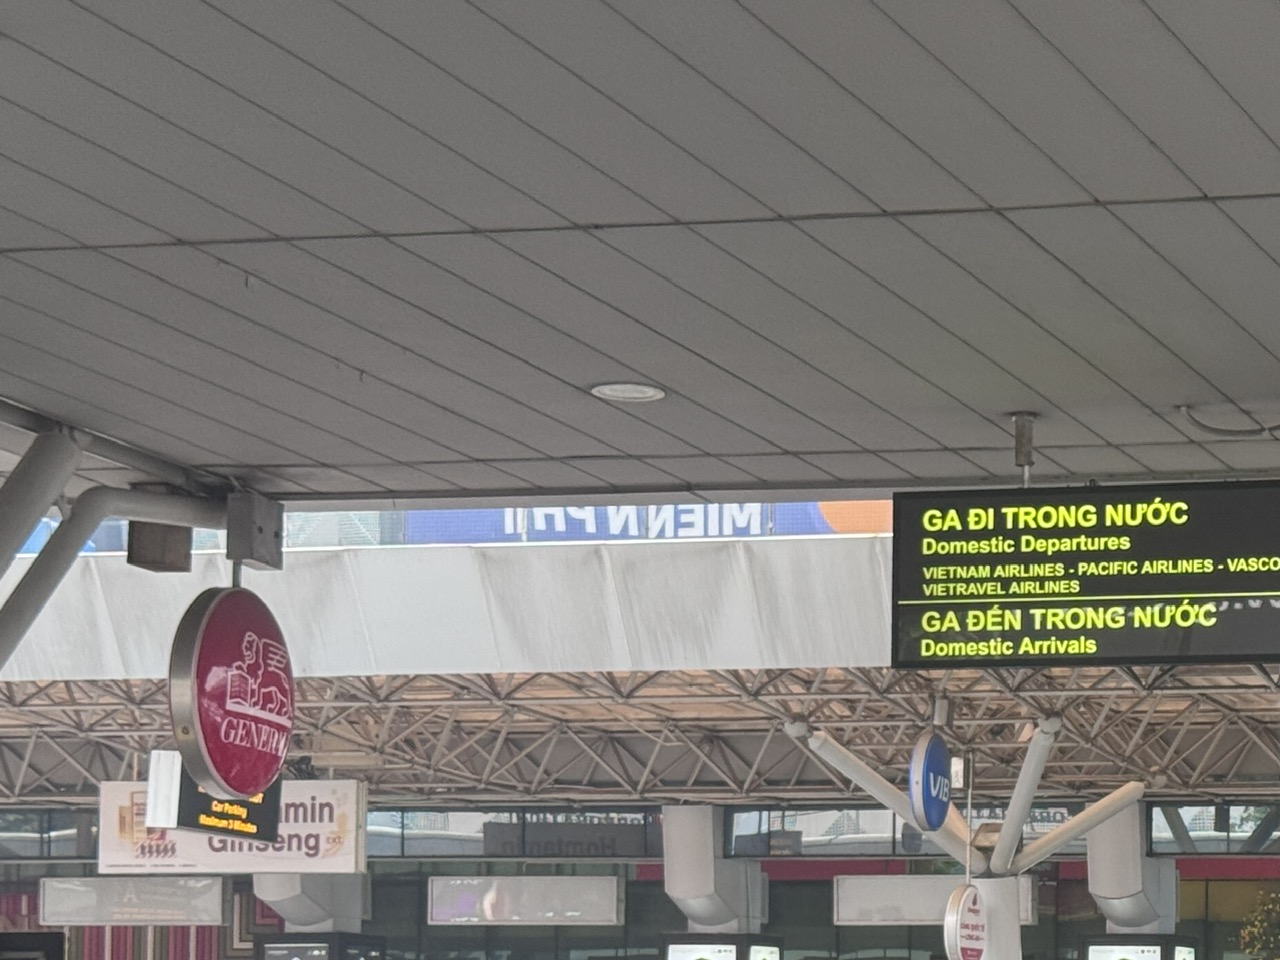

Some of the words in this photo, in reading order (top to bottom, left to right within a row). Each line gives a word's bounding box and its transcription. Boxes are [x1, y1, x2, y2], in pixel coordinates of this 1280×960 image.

[923, 509, 962, 531] GA
[967, 508, 994, 530] ĐI
[1001, 505, 1097, 529] TRONG
[1105, 498, 1188, 527] NƯỚC
[922, 536, 1015, 554] Domestic
[1021, 535, 1131, 555] Departures
[923, 565, 991, 580] VIETNAM
[994, 563, 1065, 578] AIRLINES
[1078, 560, 1138, 576] PACIFIC
[1141, 558, 1214, 575] AIRLINES
[923, 582, 1005, 596] VIETRAVEL
[1008, 580, 1080, 594] AIRLINES
[921, 610, 961, 632] GA
[1030, 606, 1126, 630] TRONG
[1133, 600, 1217, 628] NƯỚC
[921, 638, 1013, 657] Domestic
[1019, 636, 1097, 655] Arrivals
[929, 771, 950, 803] VIB
